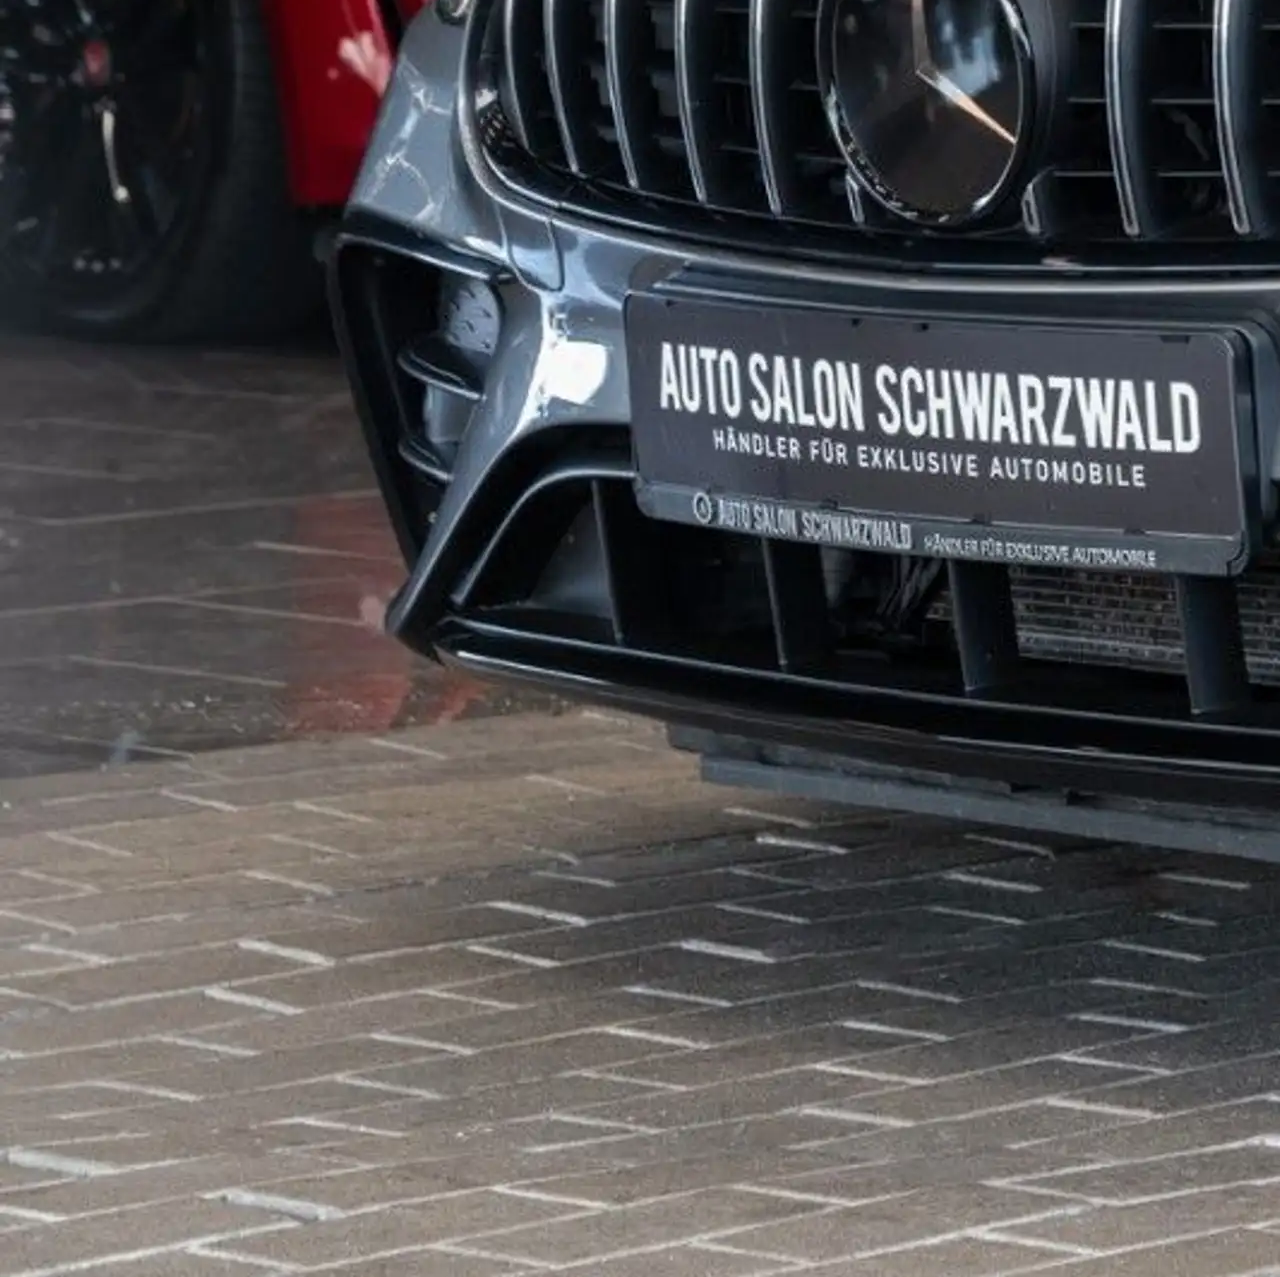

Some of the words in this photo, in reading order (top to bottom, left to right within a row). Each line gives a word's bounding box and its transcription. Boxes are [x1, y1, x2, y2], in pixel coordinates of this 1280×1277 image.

[660, 342, 741, 419] AUTO
[749, 353, 864, 431] SALON
[875, 364, 1201, 454] SCHWARZWALD
[713, 426, 800, 460] HÄNDLER
[810, 436, 847, 465] FÜR
[858, 446, 979, 478] EXKLUSIVE
[990, 456, 1146, 488] AUTOMOBILE
[753, 504, 798, 537] SALON
[801, 510, 912, 549] SCHWARZWALD
